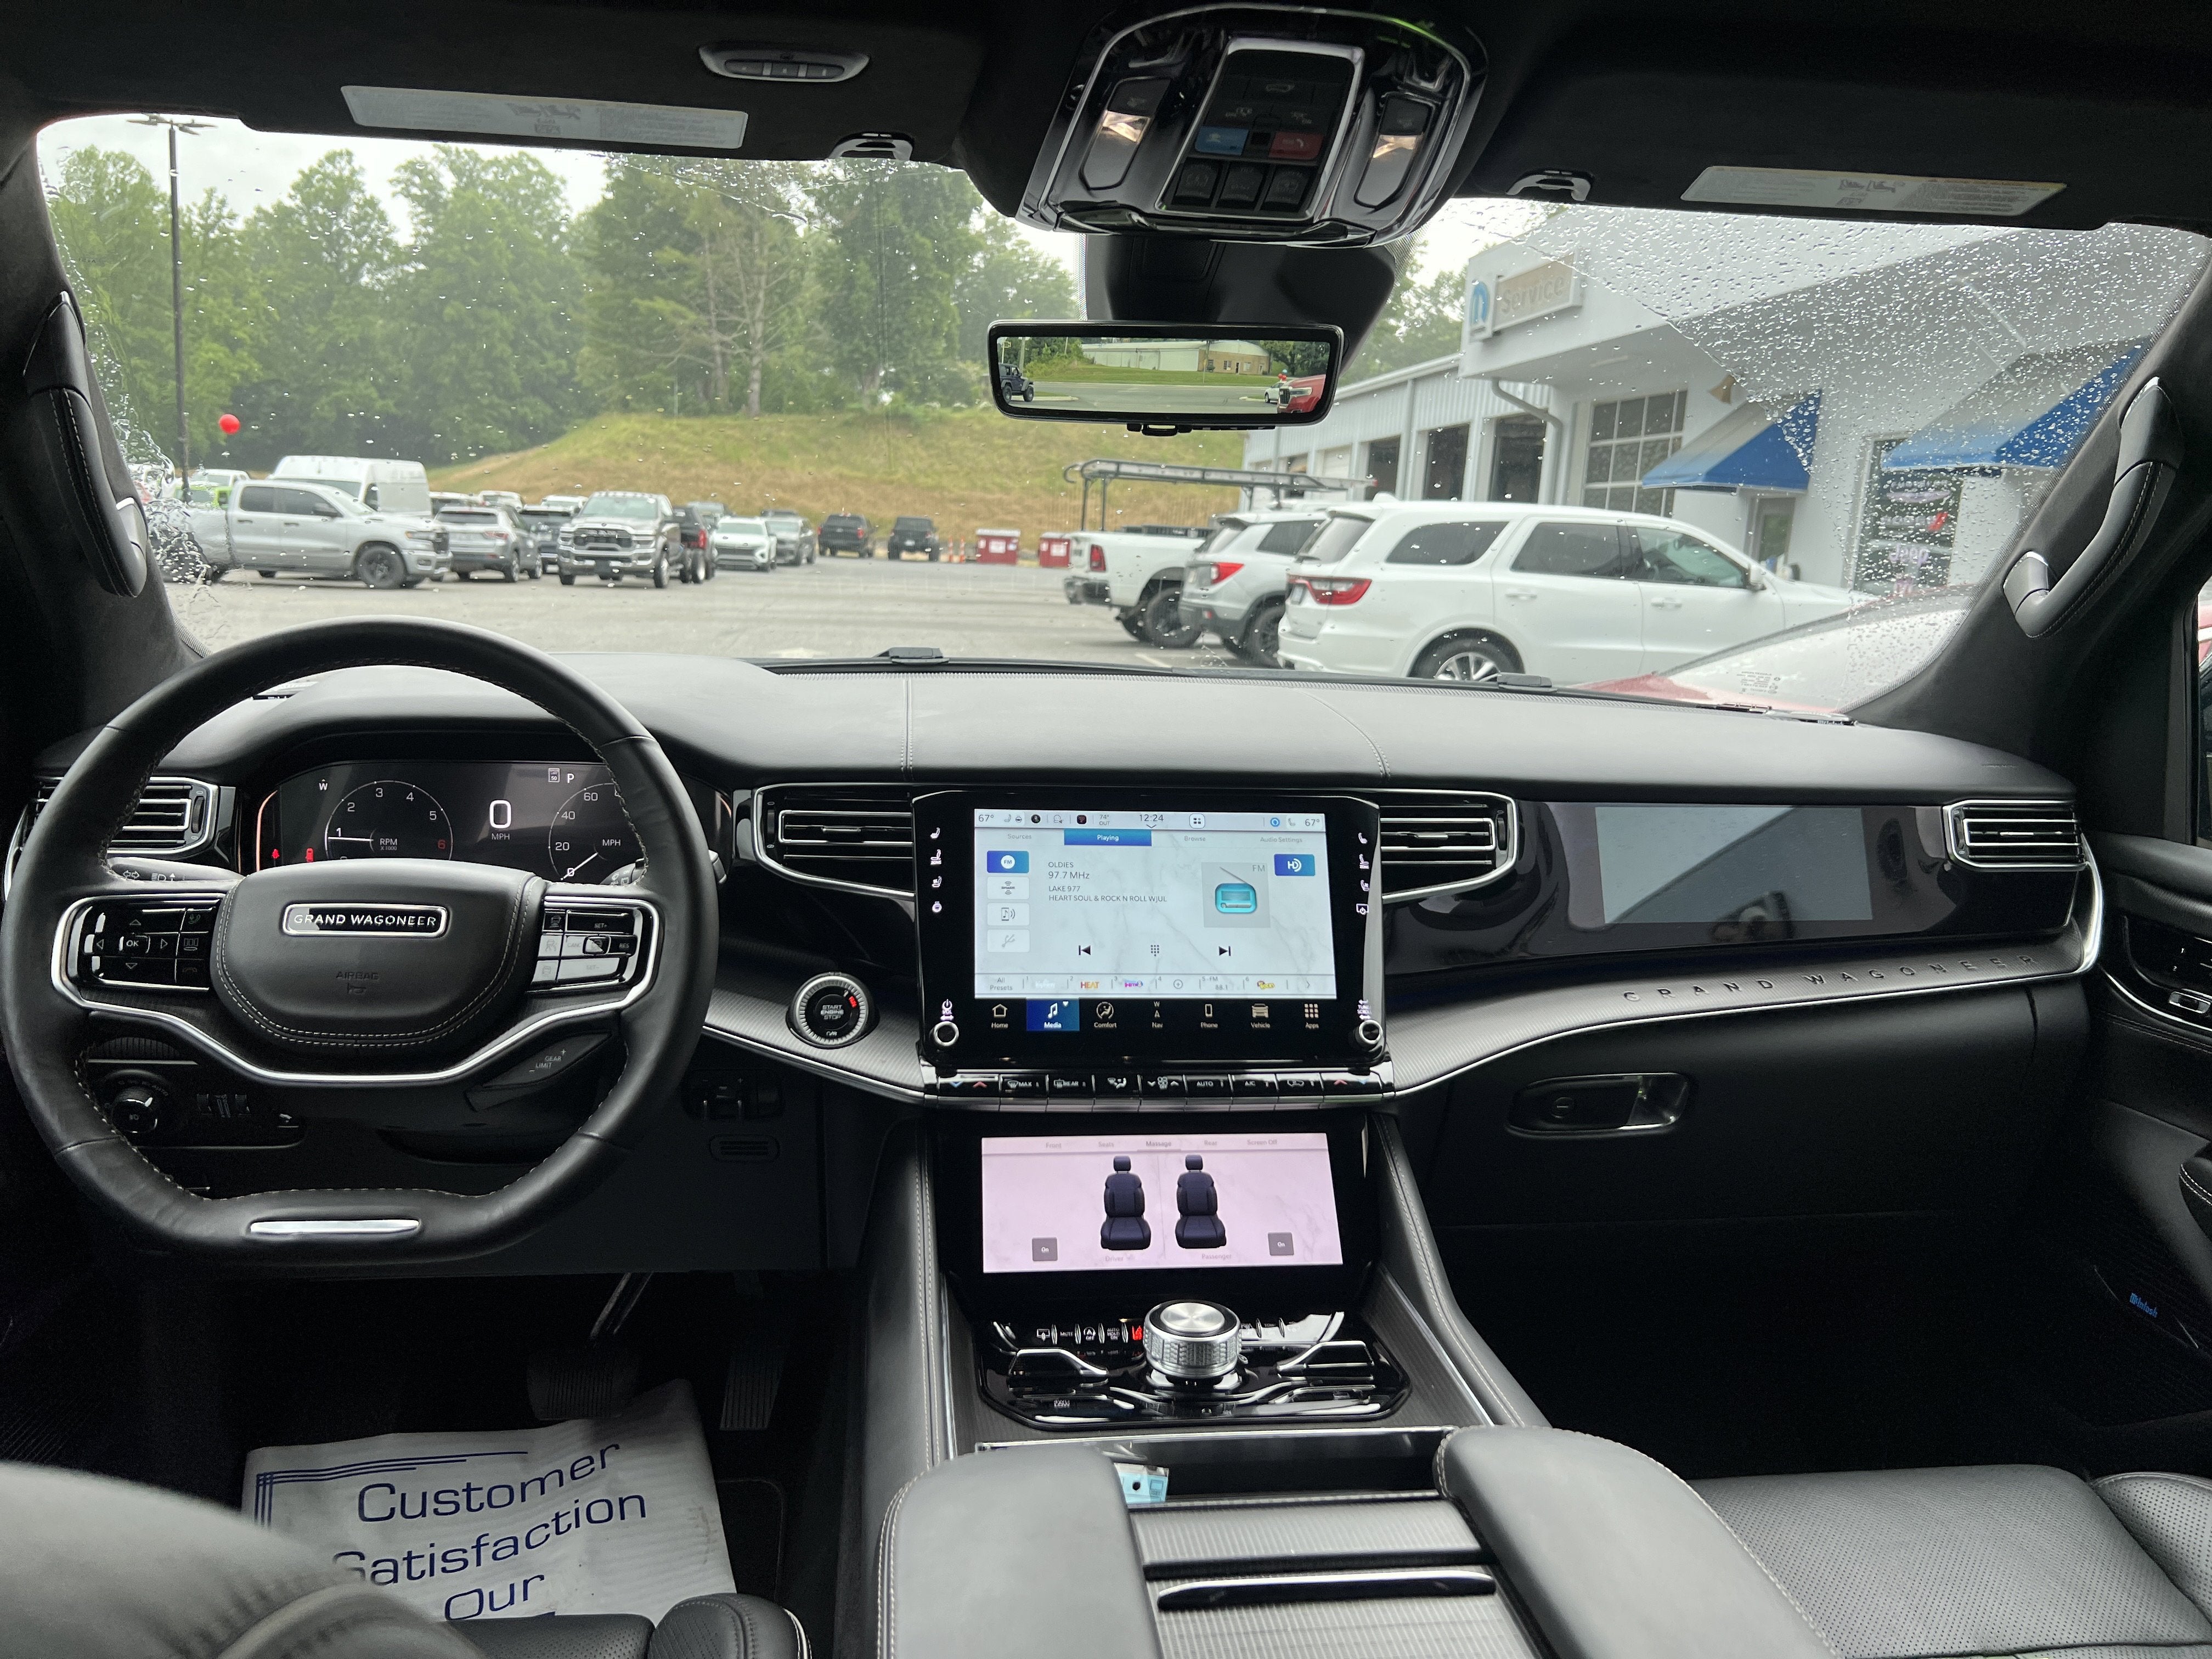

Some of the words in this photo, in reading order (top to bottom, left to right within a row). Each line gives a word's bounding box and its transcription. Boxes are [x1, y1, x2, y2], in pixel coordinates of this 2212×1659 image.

[1501, 276, 1563, 313] Service
[1889, 544, 1929, 567] Jeep
[567, 773, 574, 783] P
[375, 788, 383, 798] 3
[406, 792, 414, 802] 4
[584, 792, 598, 801] 60
[347, 802, 356, 812] 2
[429, 811, 437, 821] 5
[489, 799, 512, 829] 0
[561, 811, 575, 820] 40
[336, 827, 342, 837] 1
[437, 839, 446, 849] 6
[555, 842, 569, 850] 20
[567, 867, 575, 877] 0
[294, 914, 346, 924] GRAND
[351, 915, 437, 926] WAGONEER
[336, 971, 380, 980] AIRBAG
[1623, 979, 1774, 1002] GRAND
[1802, 954, 2039, 985] WAGONEER
[358, 1442, 620, 1523] Customer
[331, 1492, 647, 1588] Satisfaction
[444, 1574, 545, 1621] Our
